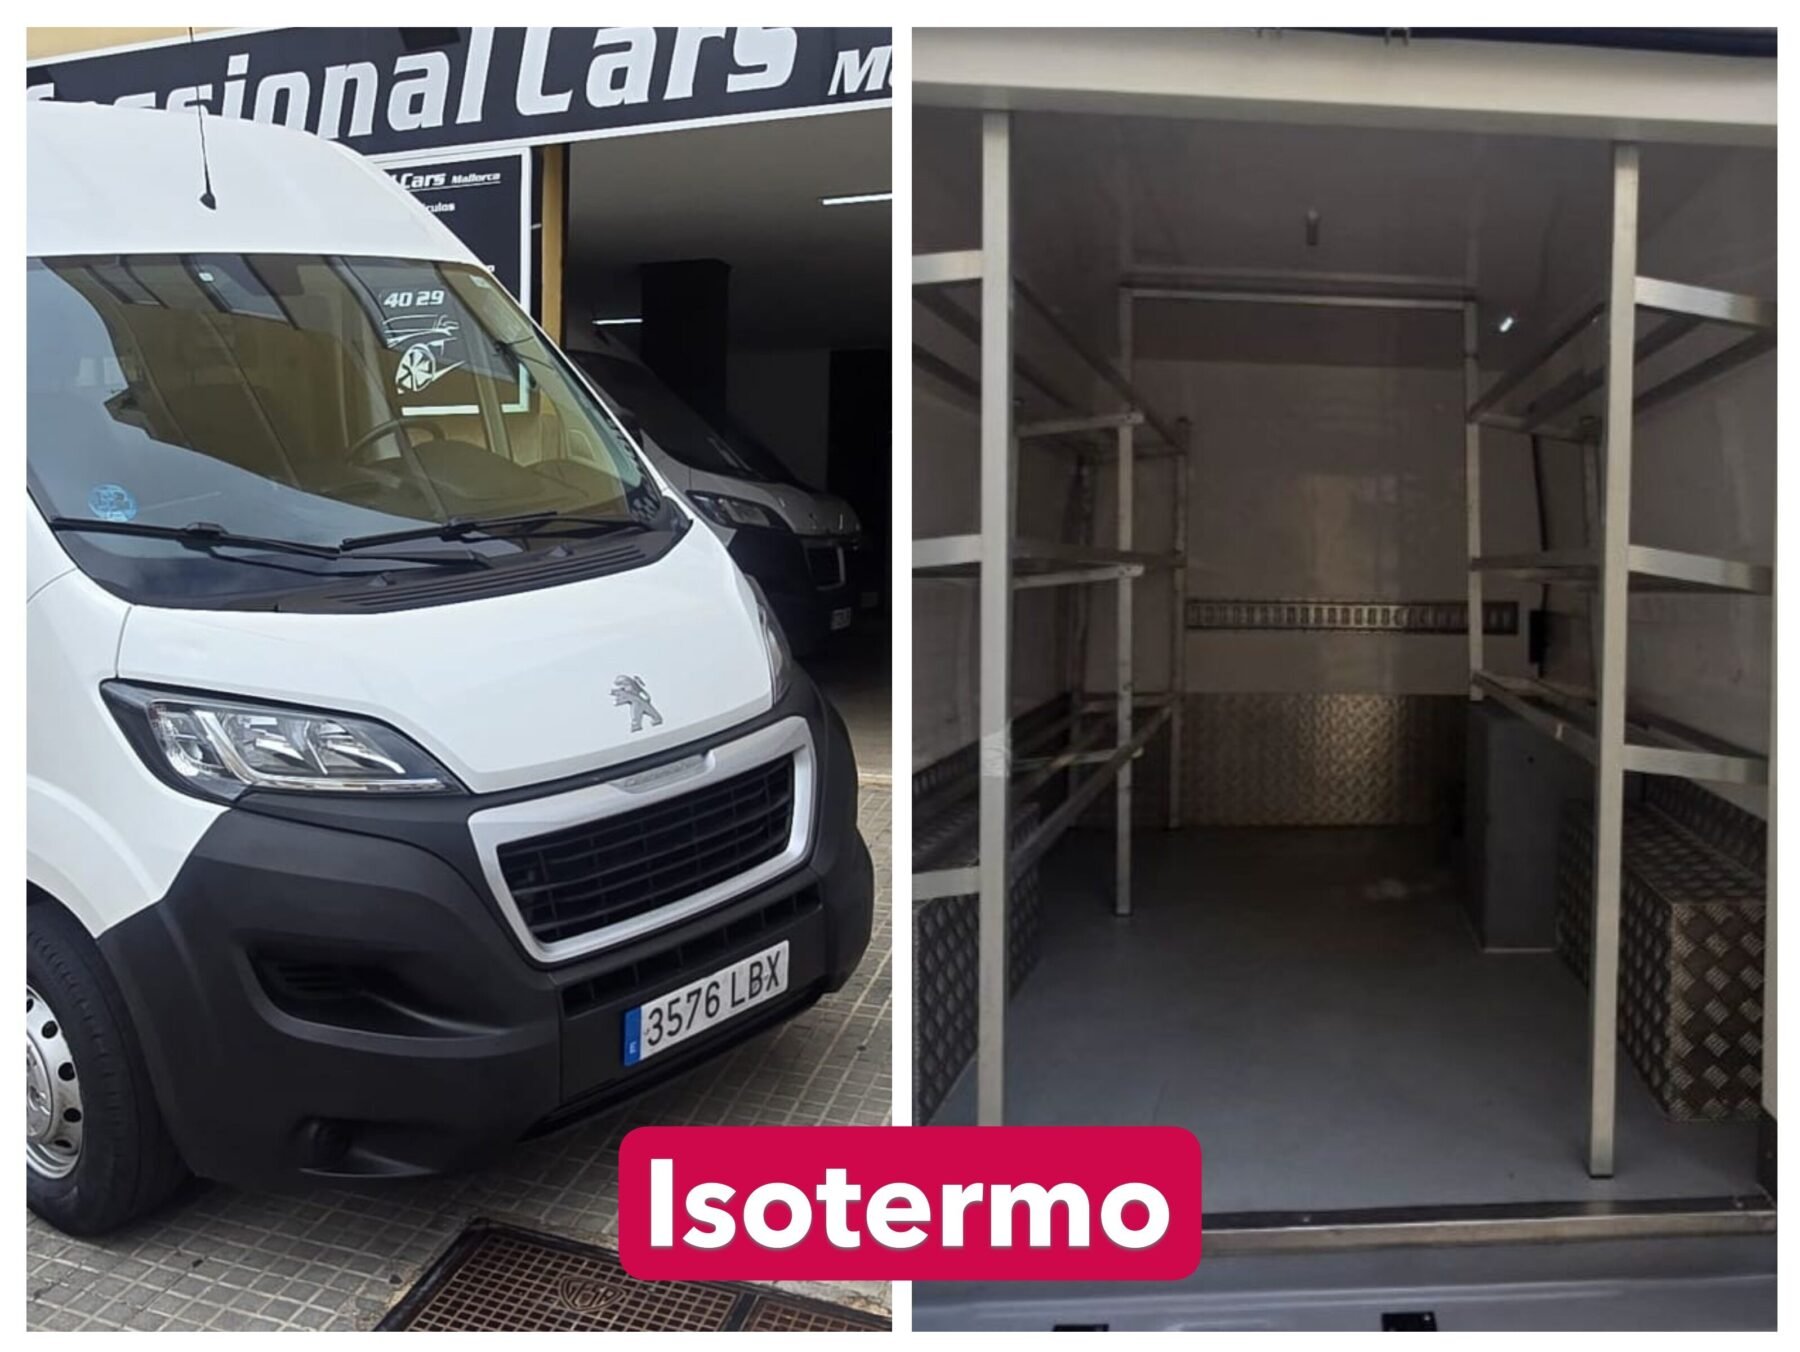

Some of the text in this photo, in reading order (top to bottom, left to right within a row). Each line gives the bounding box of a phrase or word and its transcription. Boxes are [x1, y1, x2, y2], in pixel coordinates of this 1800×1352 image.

[515, 27, 798, 116] Cars
[828, 45, 892, 96] M
[401, 172, 446, 189] Cars
[452, 172, 501, 184] Mallorca
[423, 202, 456, 213] culos
[383, 290, 445, 308] 40 29
[647, 981, 720, 1046] 3576
[731, 951, 780, 1007] LBX
